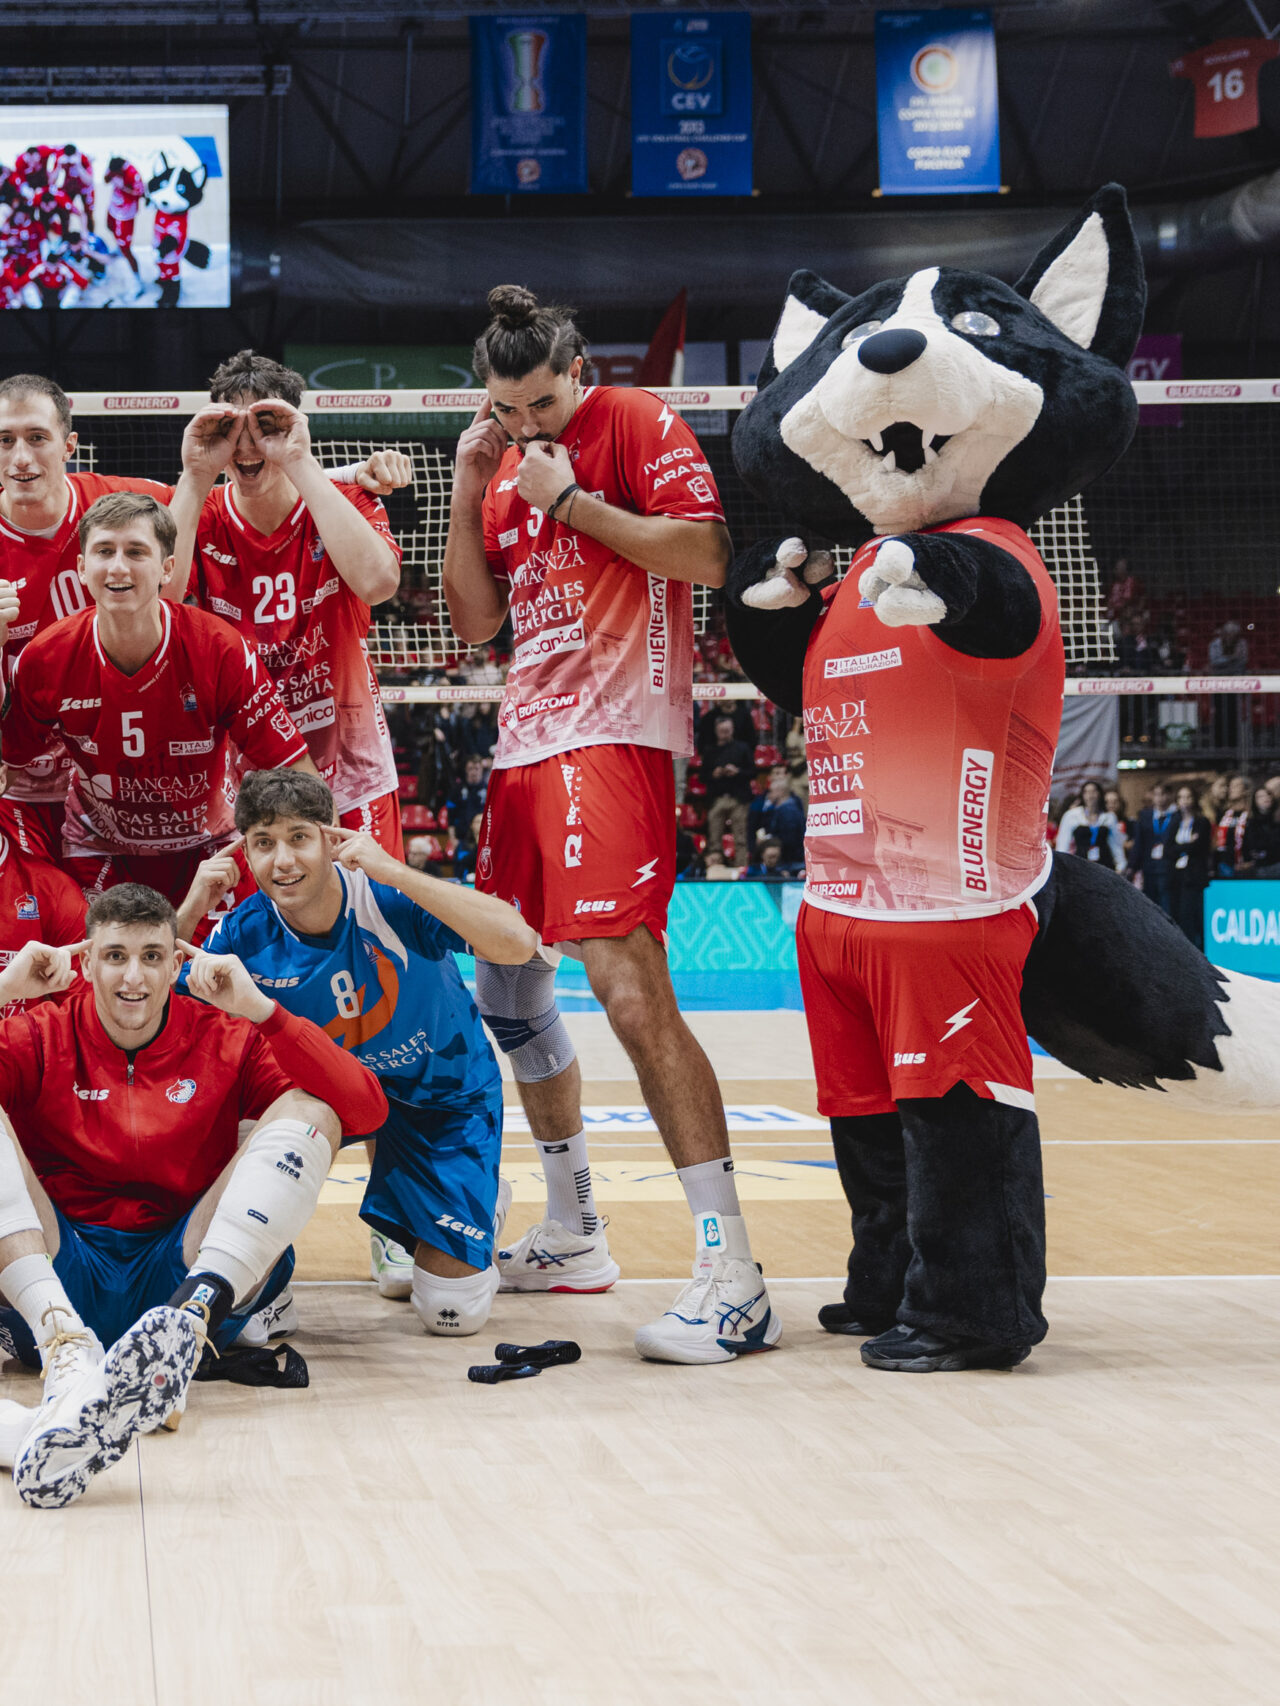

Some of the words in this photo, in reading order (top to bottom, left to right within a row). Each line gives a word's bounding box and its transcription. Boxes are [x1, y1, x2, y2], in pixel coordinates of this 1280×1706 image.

[1207, 68, 1244, 102] 16
[671, 92, 712, 111] CEV
[107, 397, 177, 409] BLUENERGY
[320, 395, 390, 407] BLUENERGY
[425, 394, 487, 406] BLUENERG
[659, 391, 705, 404] ENERGY
[644, 448, 694, 476] IVECO
[653, 466, 689, 492] ARA
[202, 543, 238, 566] Zeus
[558, 535, 579, 553] DI
[12, 577, 27, 591] us
[49, 569, 87, 621] 10
[213, 598, 240, 615] LIANA
[252, 572, 297, 625] 23
[650, 577, 667, 688] BLUENERGY
[257, 635, 311, 656] BANCA
[839, 650, 898, 669] ITALIANA
[839, 658, 899, 674] ASSICURAZIONI
[289, 661, 331, 690] SALES
[58, 697, 102, 713] Zeus
[280, 681, 335, 708] ERGIA
[246, 703, 271, 729] ARA
[518, 695, 575, 718] BURZONI
[804, 707, 835, 727] NCA
[841, 700, 868, 719] DI
[121, 710, 146, 758] 5
[805, 718, 871, 744] CENZA
[183, 740, 212, 750] ITALI
[815, 752, 865, 773] SALES
[119, 774, 181, 792] BANCA
[189, 770, 209, 787] DI
[120, 780, 210, 803] PIACENZA
[809, 773, 865, 796] ERGIA
[119, 808, 153, 826] GAS
[158, 801, 209, 824] SALES
[966, 757, 989, 893] BLUENERGY
[574, 900, 617, 915] Zeus
[1211, 908, 1280, 945] CALDA
[250, 972, 300, 988] Zeus
[330, 970, 360, 1019] 8
[359, 1051, 377, 1066] AS
[379, 1028, 428, 1061] SALES
[365, 1041, 435, 1072] NERGIA
[276, 1160, 300, 1180] errea
[435, 1214, 487, 1241] Zeus
[436, 1320, 460, 1329] errea
